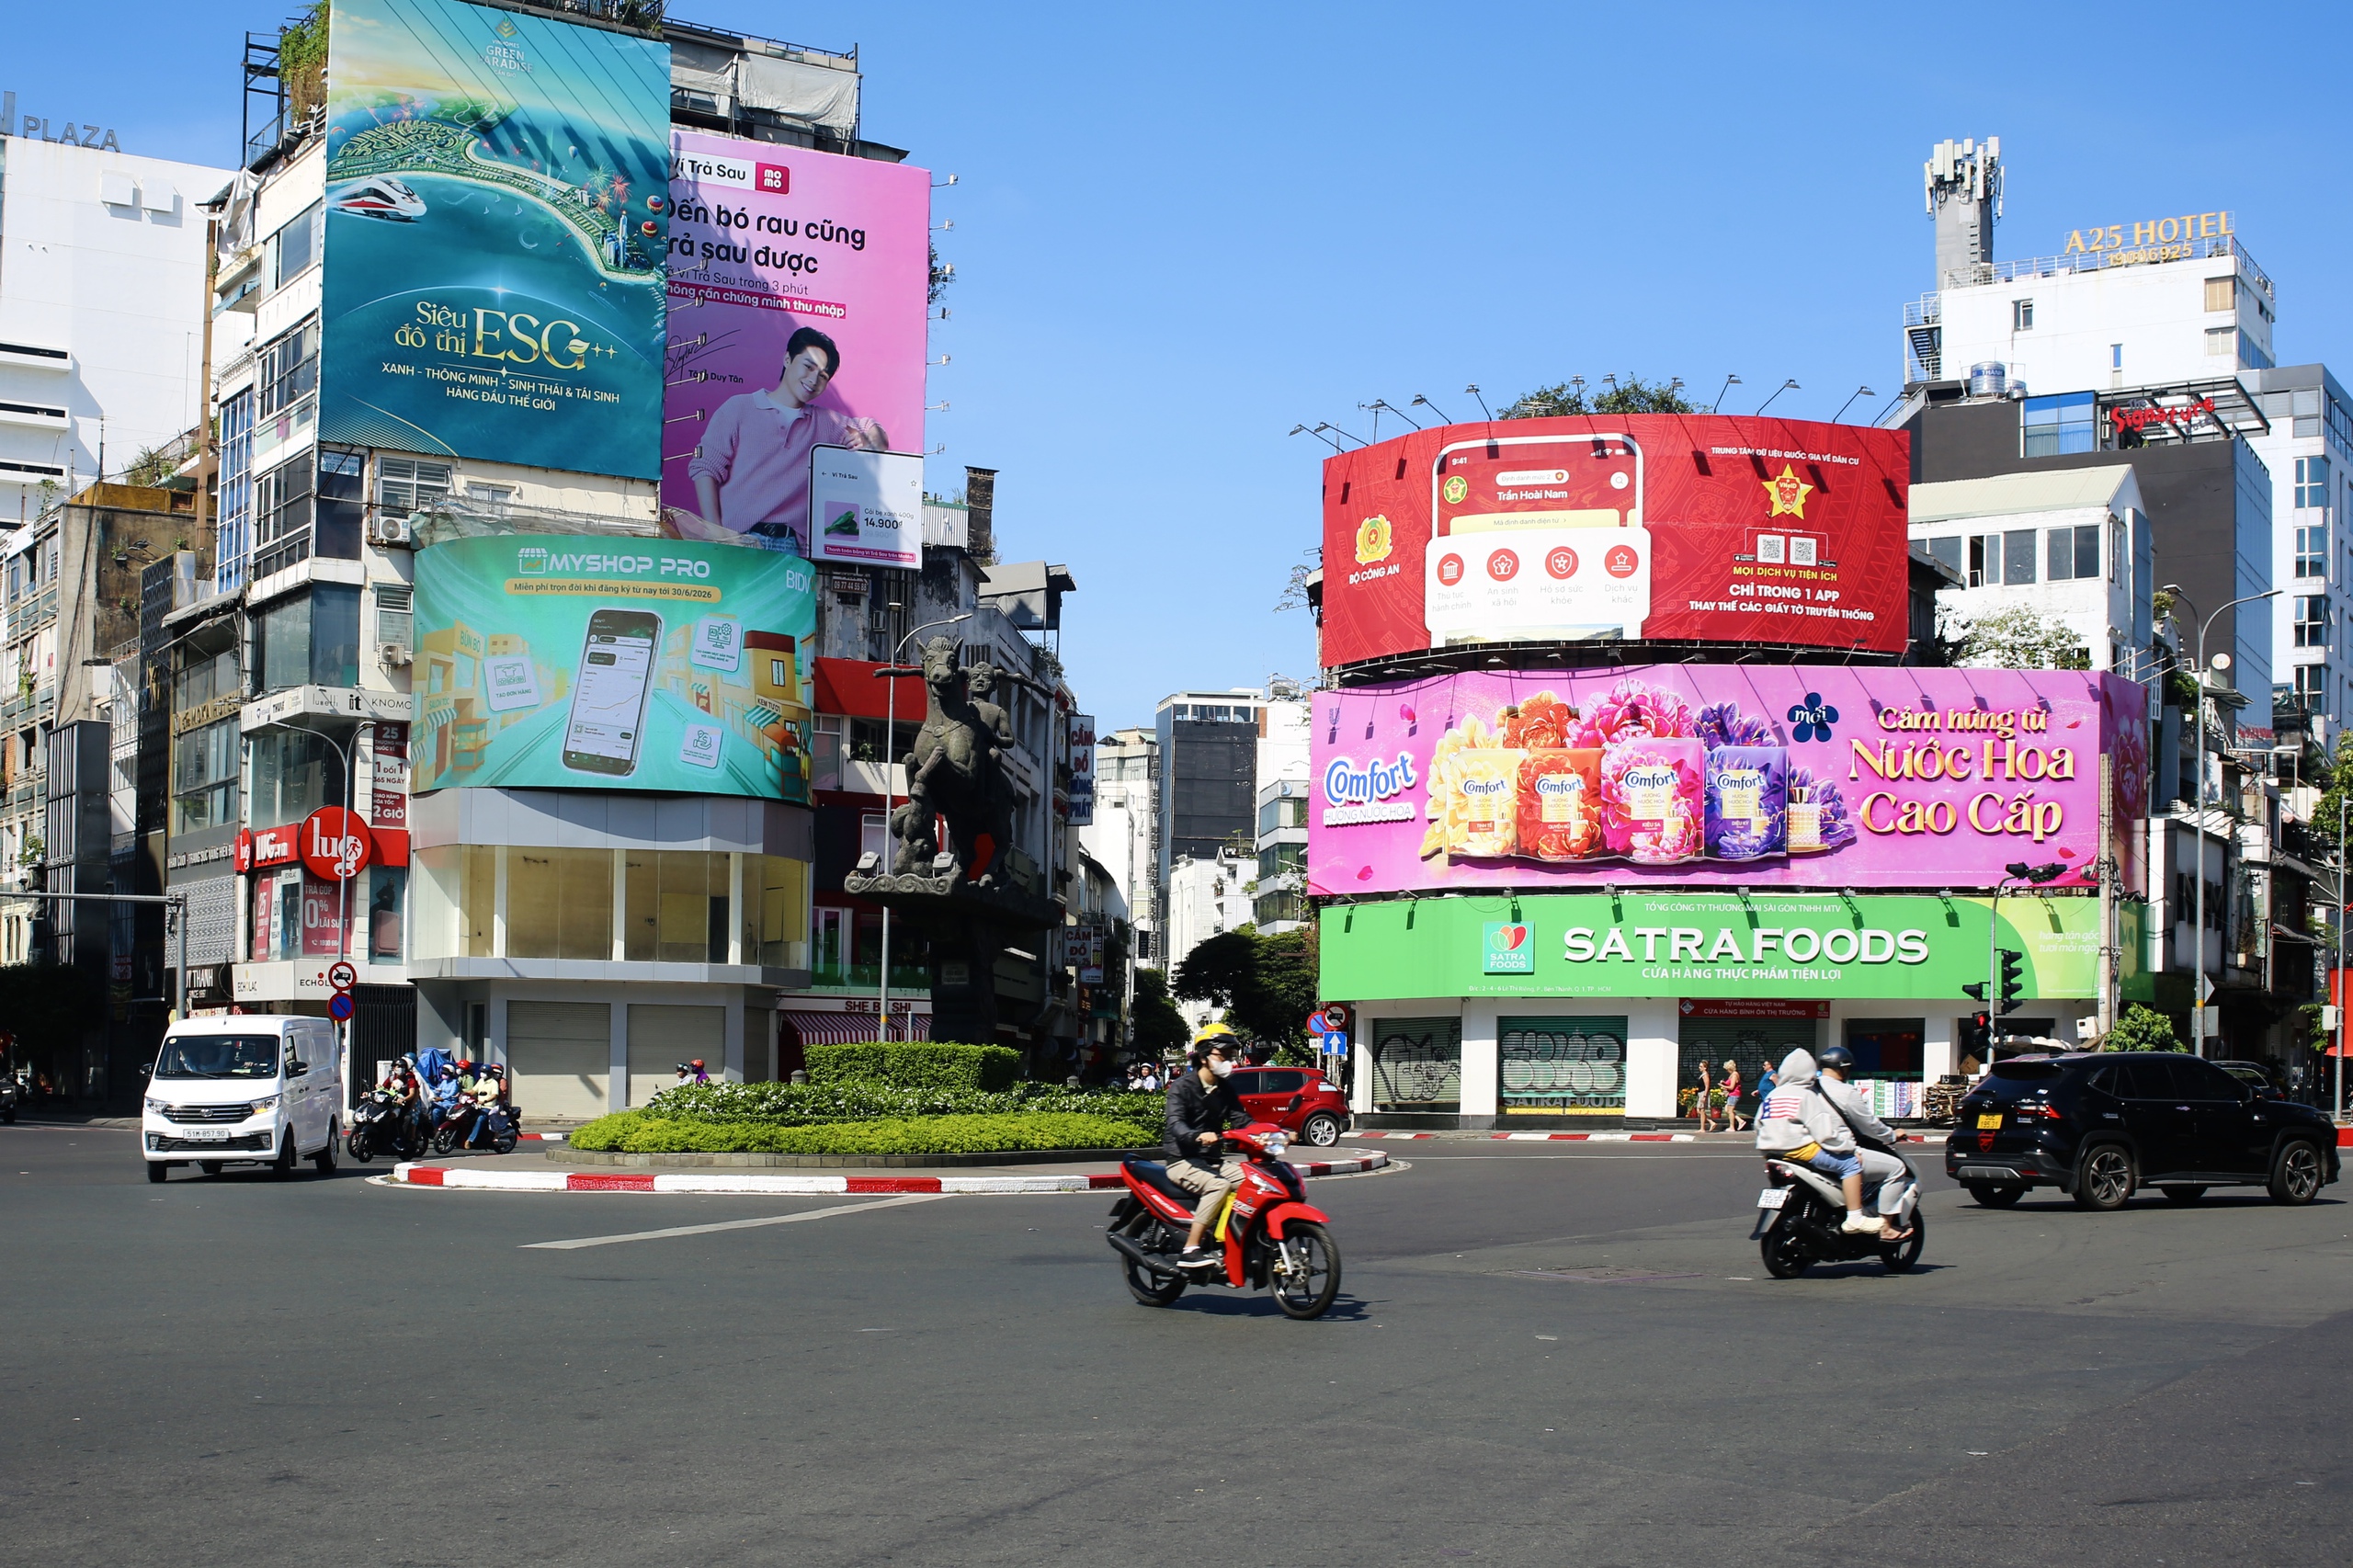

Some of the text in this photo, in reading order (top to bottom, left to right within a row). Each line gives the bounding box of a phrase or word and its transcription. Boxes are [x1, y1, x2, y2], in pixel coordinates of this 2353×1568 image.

[486, 46, 524, 61] GREEN
[23, 116, 120, 153] PLAZA
[688, 160, 745, 180] Trả Sau
[717, 204, 866, 250] bó rau cũng
[2064, 210, 2234, 255] A25 HOTEL
[701, 241, 818, 277] sau được
[713, 273, 809, 295] Sau trong 3 phút
[415, 301, 466, 328] Siêu
[762, 297, 790, 309] minh
[793, 300, 813, 312] thu
[814, 302, 845, 318] nhập
[394, 324, 467, 358] đô thị
[382, 362, 620, 403] XANH THÔNG MINH SINH THÁI & TÁI SINH
[710, 373, 744, 384] Duy Tân
[447, 386, 479, 402] HÀNG
[2111, 397, 2215, 434] Signature
[1452, 457, 1468, 465] 9:41
[1711, 446, 1859, 465] TRUNG TÂM LIỆU QUỐC GIA DÂN CƯ
[1496, 489, 1568, 501] Trần Hoài Nam
[550, 553, 710, 578] MYSHOP PRO
[1349, 562, 1400, 585] BỘ CÔNG AN
[1733, 566, 1838, 581] MỌI DỊCH VỤ TIỆN ÍCH
[536, 583, 549, 594] phí
[551, 584, 567, 594] trọn
[568, 583, 583, 592] đời
[584, 583, 597, 593] khi
[598, 585, 620, 595] đăng
[620, 585, 631, 596] ký
[643, 587, 657, 597] nay
[659, 586, 670, 596] tới
[672, 587, 712, 599] 30/6/2026
[1487, 587, 1499, 596] An
[1612, 596, 1633, 604] khác
[1729, 582, 1840, 602] CHỈ TRONG 1 APP
[1689, 600, 1875, 621] THAY THẾ CÁC GIẤY TỜ THỐNG
[349, 694, 362, 711] it
[757, 698, 768, 708] KEM
[1879, 704, 1941, 730] Cảm
[1948, 706, 2016, 738] hứng
[2021, 706, 2047, 730] từ
[382, 727, 399, 739] 25
[1071, 723, 1093, 746] CẦM
[1074, 750, 1088, 773] ĐỒ
[1848, 737, 2075, 779] Nước Hoa
[375, 762, 404, 775] 1 1
[1326, 756, 1414, 803] Comfort
[1464, 779, 1506, 796] Comfort
[1537, 778, 1584, 794] Comfort
[1625, 770, 1678, 790] Comfort
[1717, 774, 1765, 791] Comfort
[373, 805, 404, 819] 2 GIỜ
[1070, 798, 1091, 818] PHÁT
[1325, 806, 1412, 823] HƯƠNG HOA
[1861, 789, 2063, 842] Cao Cấp
[311, 816, 364, 878] lug
[305, 883, 333, 895] TRẢ GÓP
[1670, 902, 1695, 912] CÔNG
[1708, 903, 1745, 912] THƯƠNG
[1763, 903, 1777, 912] SÀI
[1778, 903, 1797, 913] GÒN
[320, 917, 330, 928] LÃI
[1067, 927, 1092, 941] CẦM
[1069, 942, 1087, 956] ĐỒ
[1564, 926, 1928, 964] SATRA FOODS
[1490, 953, 1526, 961] SATRA
[193, 969, 213, 988] THANH
[1642, 965, 1842, 982] CỬA HÀNG THỰC PHẨM TIỆN LỢI
[845, 1000, 869, 1012] SHE
[892, 1003, 911, 1013] SHI
